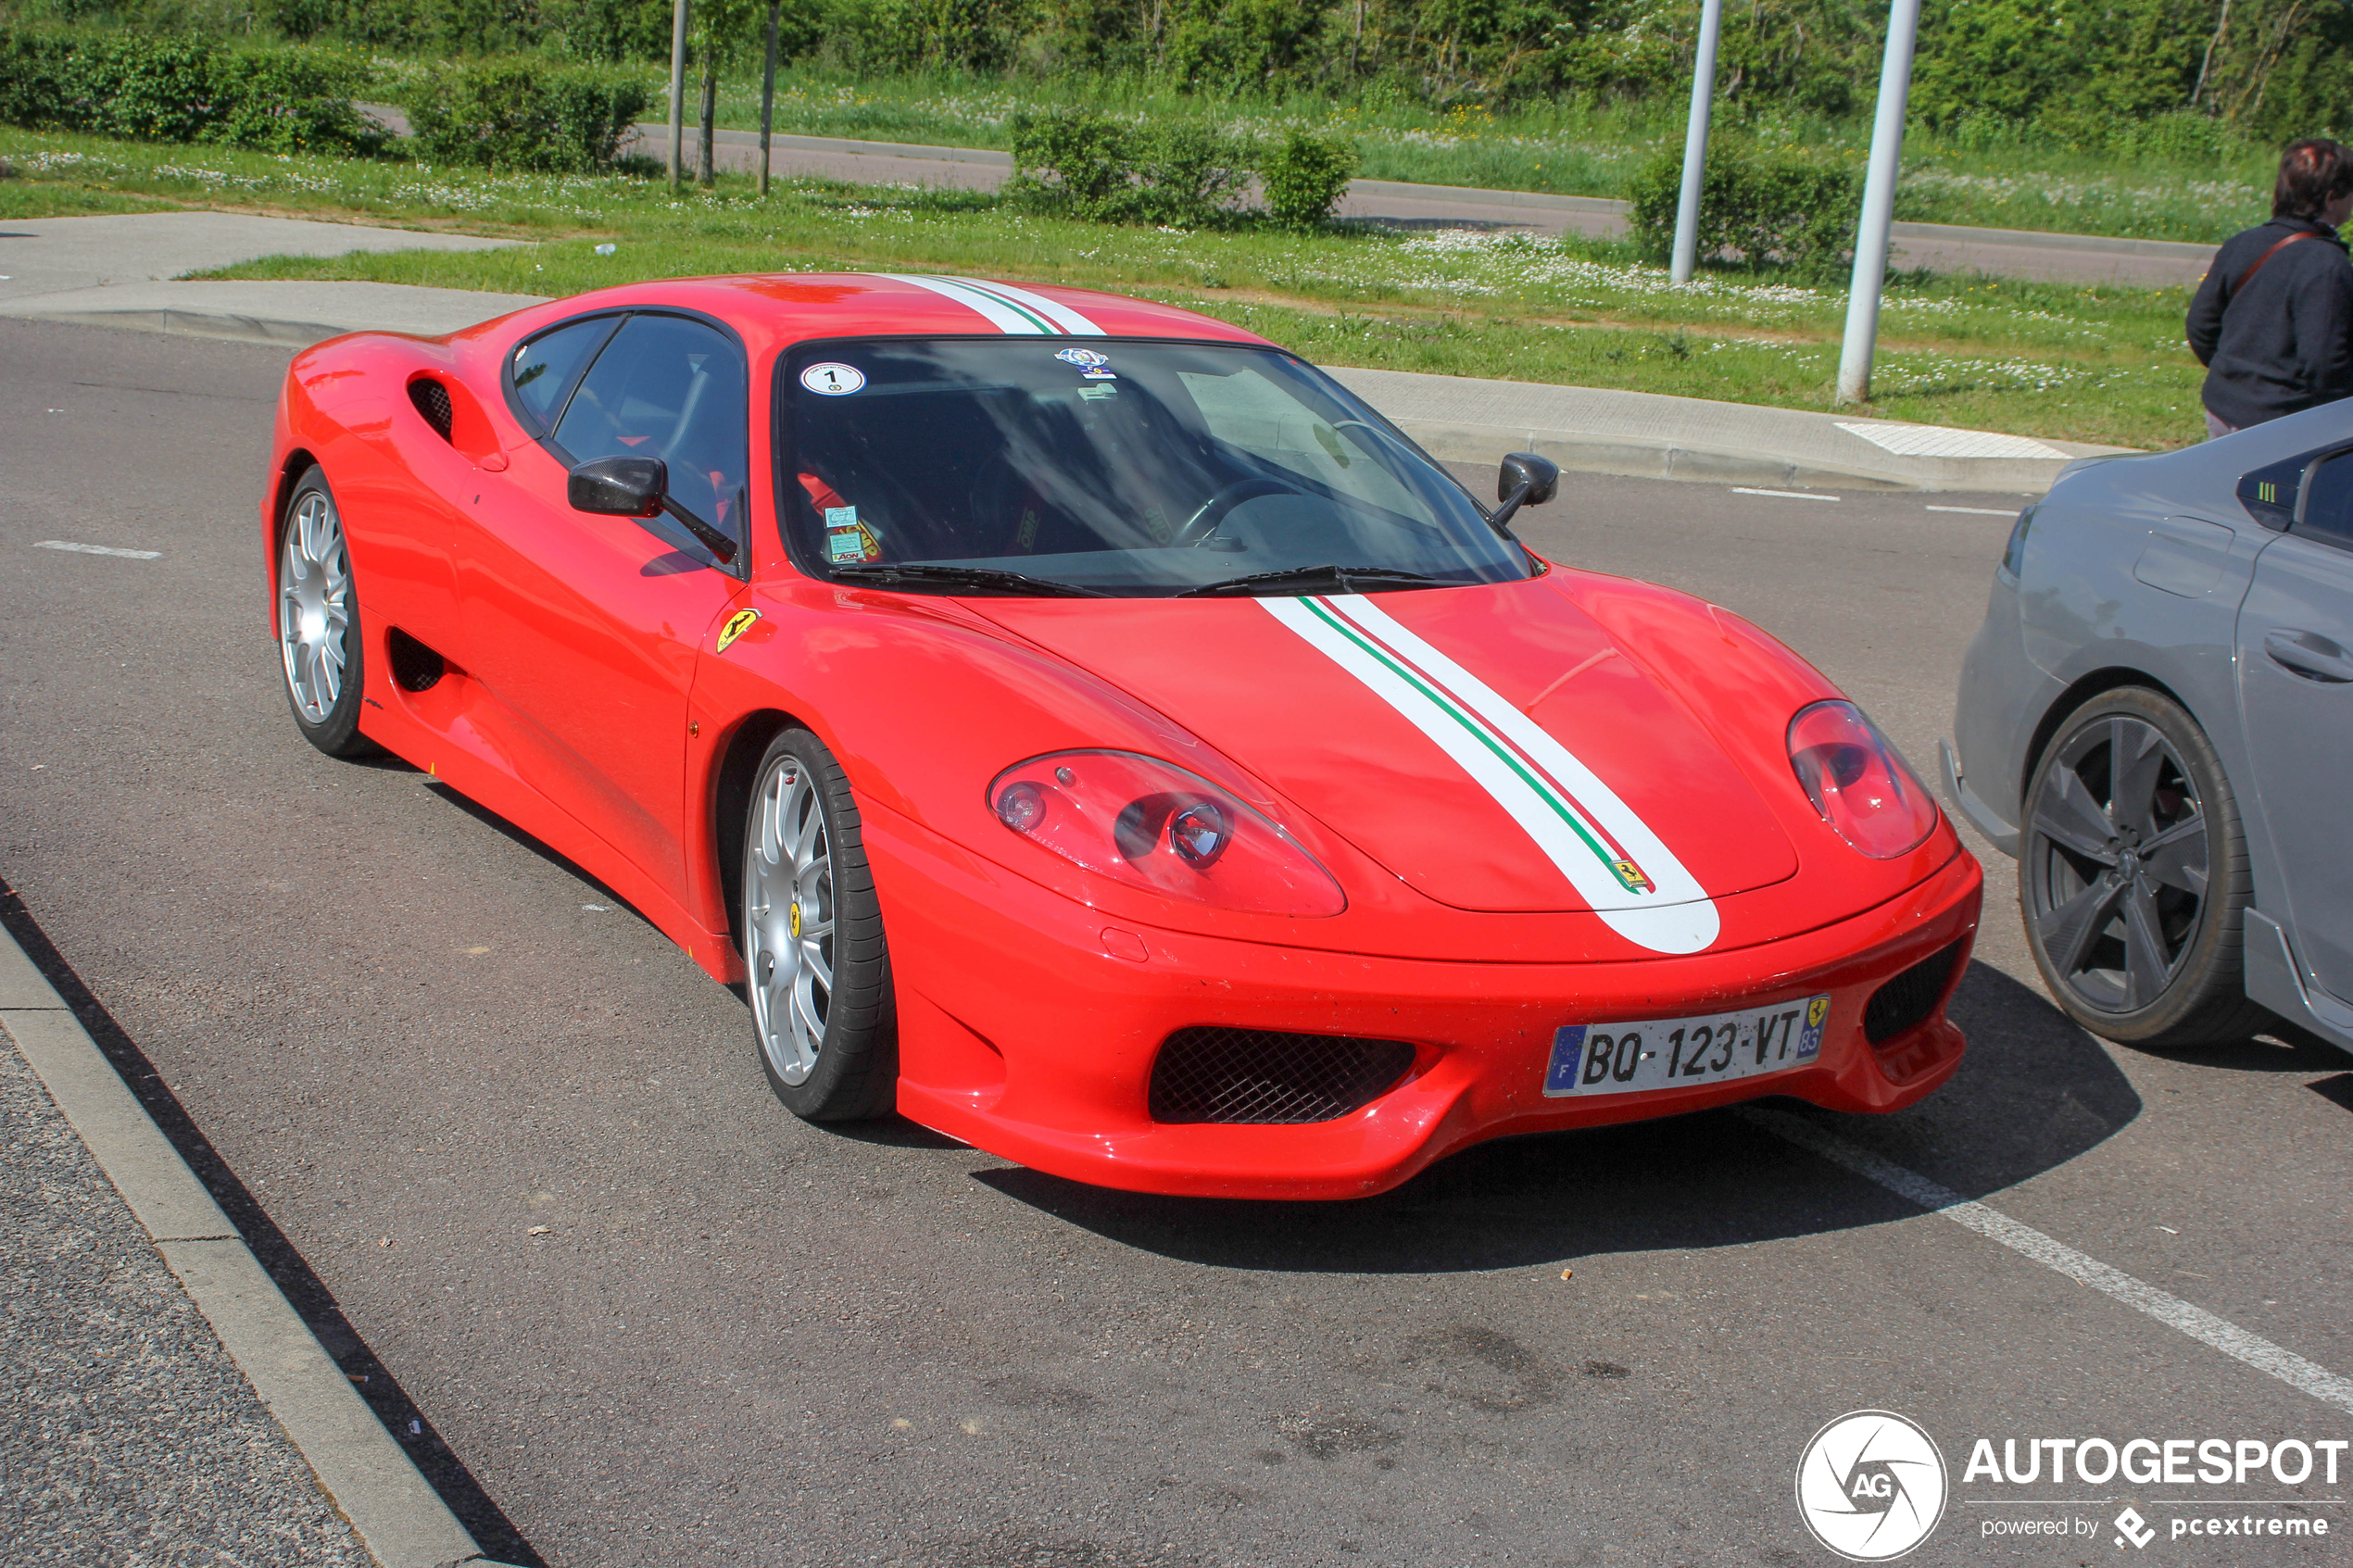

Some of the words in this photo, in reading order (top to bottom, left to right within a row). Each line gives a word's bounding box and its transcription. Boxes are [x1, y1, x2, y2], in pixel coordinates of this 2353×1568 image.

[824, 370, 837, 383] 1
[1558, 1064, 1569, 1079] F
[1800, 1029, 1819, 1053] 83
